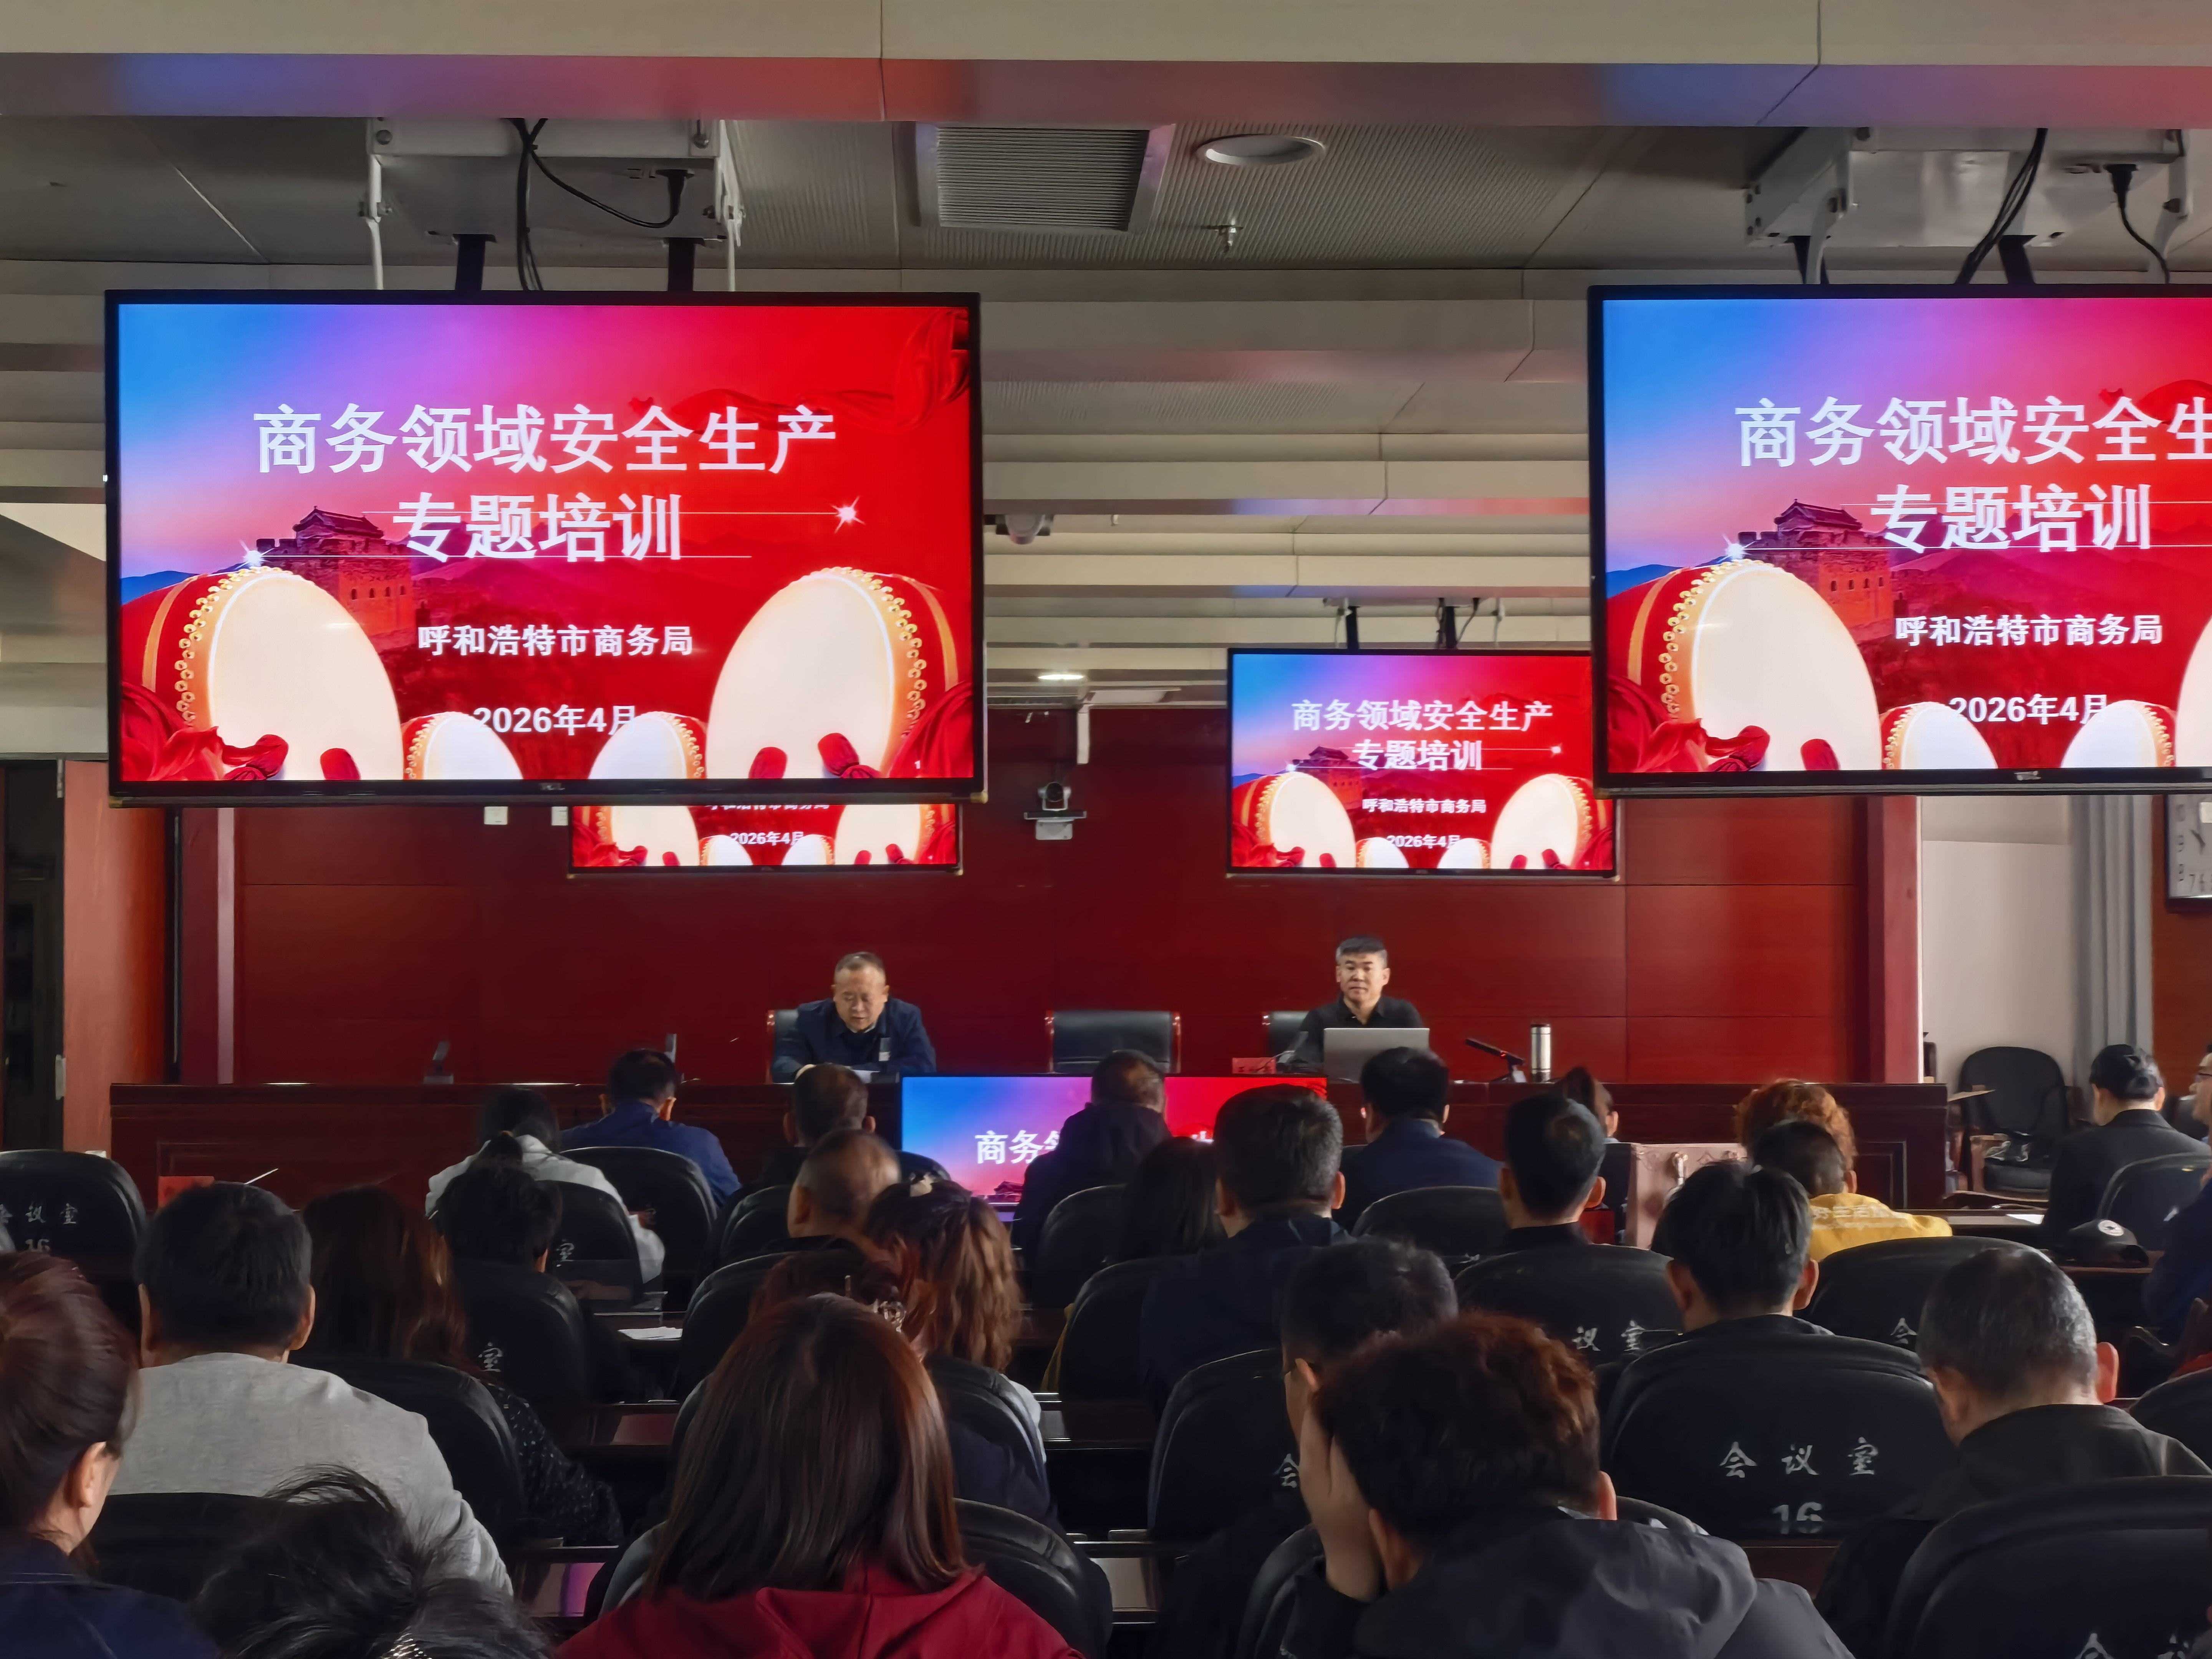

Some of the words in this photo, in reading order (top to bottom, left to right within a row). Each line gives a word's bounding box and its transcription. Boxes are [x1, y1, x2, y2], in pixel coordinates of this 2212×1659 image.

[253, 403, 835, 474] 商务领域安全生产
[1735, 396, 2212, 467] 商务领域安全生
[393, 492, 681, 562] 专题培训
[1871, 483, 2151, 554] 专题培训
[418, 624, 692, 656] 呼和浩特市商务局
[1896, 614, 2163, 646] 呼和浩特市商务局
[474, 704, 635, 735] 2026年4月
[1291, 699, 1553, 732] 商务领域安全生产
[1949, 694, 2107, 725] 2026年4月
[1352, 739, 1482, 771] 专题培训
[1362, 798, 1487, 813] 呼和浩特市商务局
[1719, 1437, 1879, 1478] 会议室
